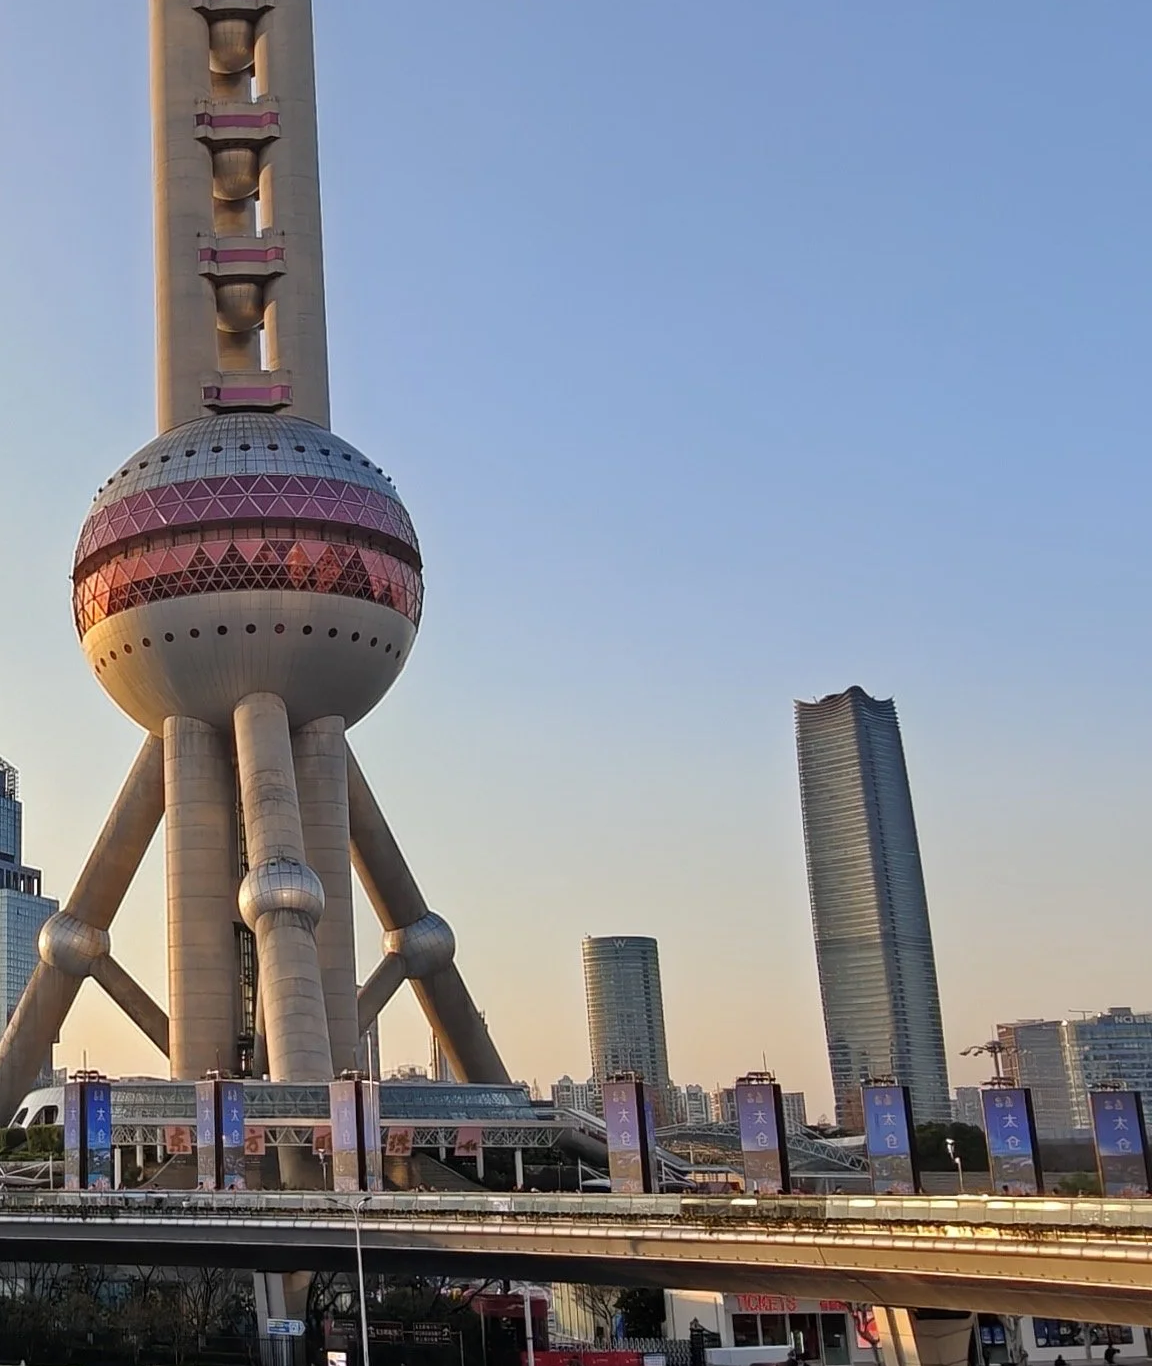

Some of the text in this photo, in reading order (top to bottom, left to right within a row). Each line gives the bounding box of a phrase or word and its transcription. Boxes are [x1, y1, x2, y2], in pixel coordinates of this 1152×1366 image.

[612, 938, 627, 948] W
[617, 1108, 632, 1146] 太仓
[752, 1110, 769, 1147] 太仓
[881, 1112, 898, 1149] 太仓
[1002, 1112, 1022, 1151] 太仓
[1112, 1115, 1133, 1153] 太仓
[737, 1295, 798, 1312] TICKETS
